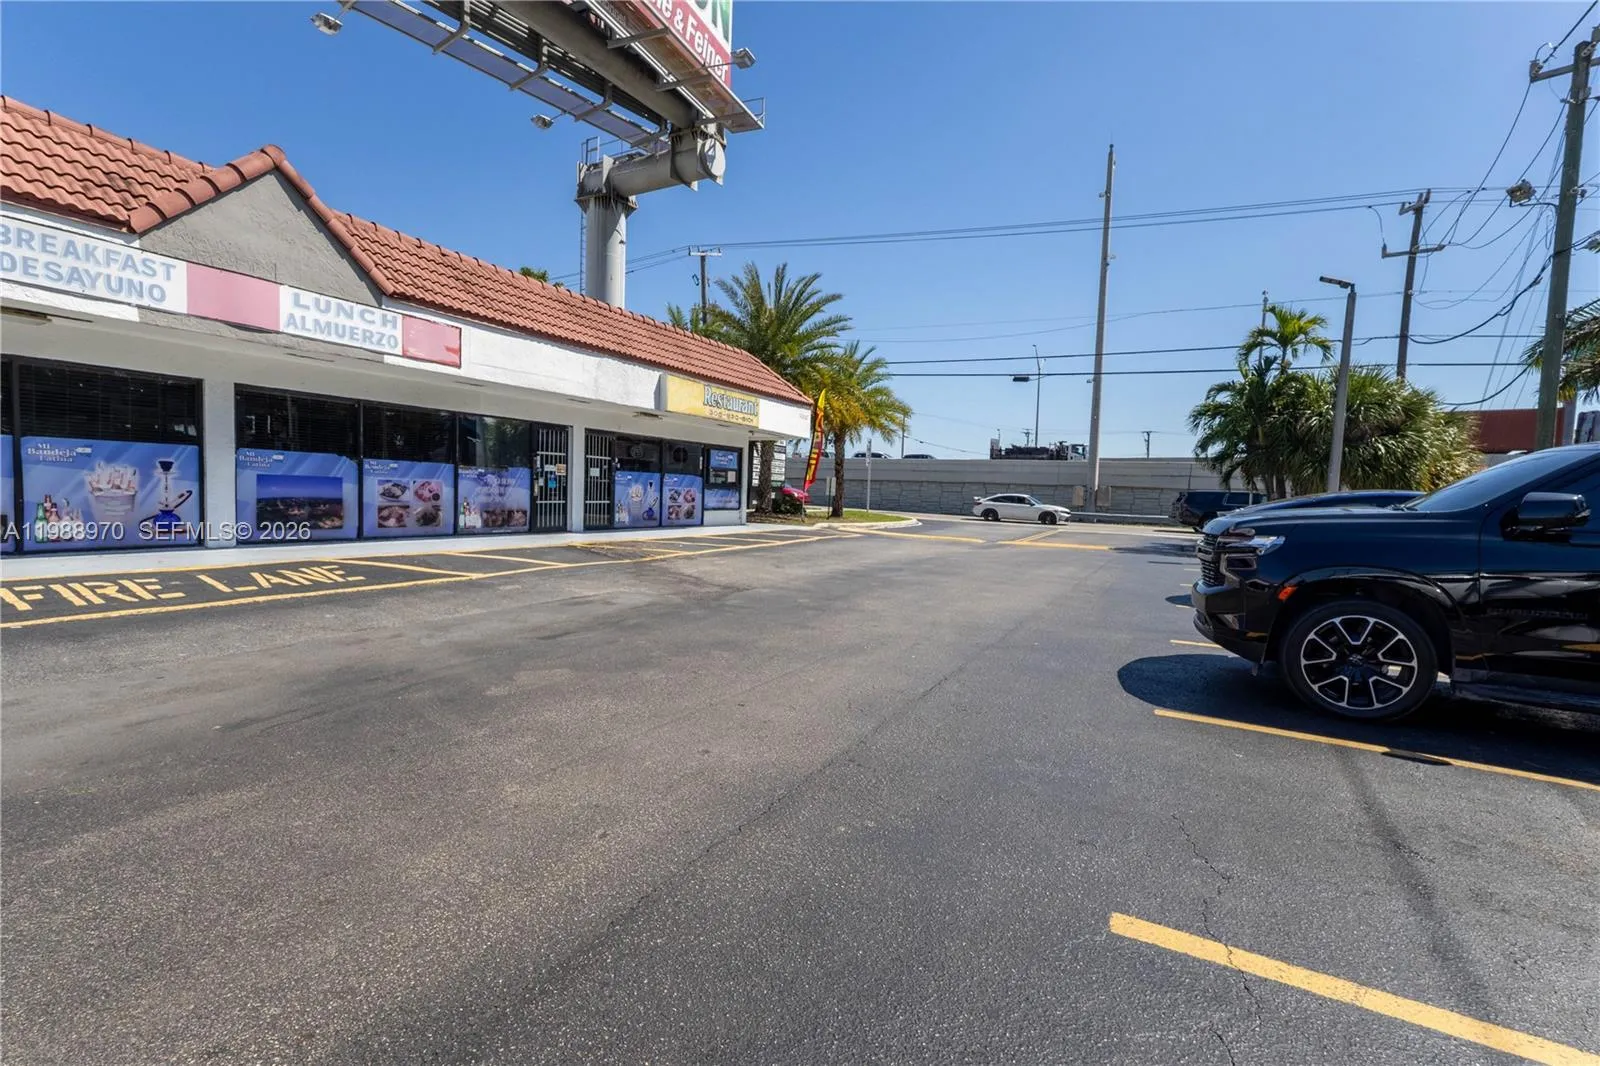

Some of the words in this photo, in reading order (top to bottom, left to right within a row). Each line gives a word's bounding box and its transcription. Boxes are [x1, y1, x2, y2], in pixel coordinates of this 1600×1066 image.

[673, 8, 684, 33] &
[685, 14, 729, 81] Feiner
[0, 223, 177, 281] BREAKFAST
[0, 251, 167, 304] DESAYUNO
[285, 312, 399, 350] ALMUERZO
[290, 292, 398, 330] LUNCH
[703, 384, 759, 416] Restaurant
[27, 448, 77, 457] Bandeja
[0, 578, 186, 611] FIRE
[196, 565, 367, 593] LANE
